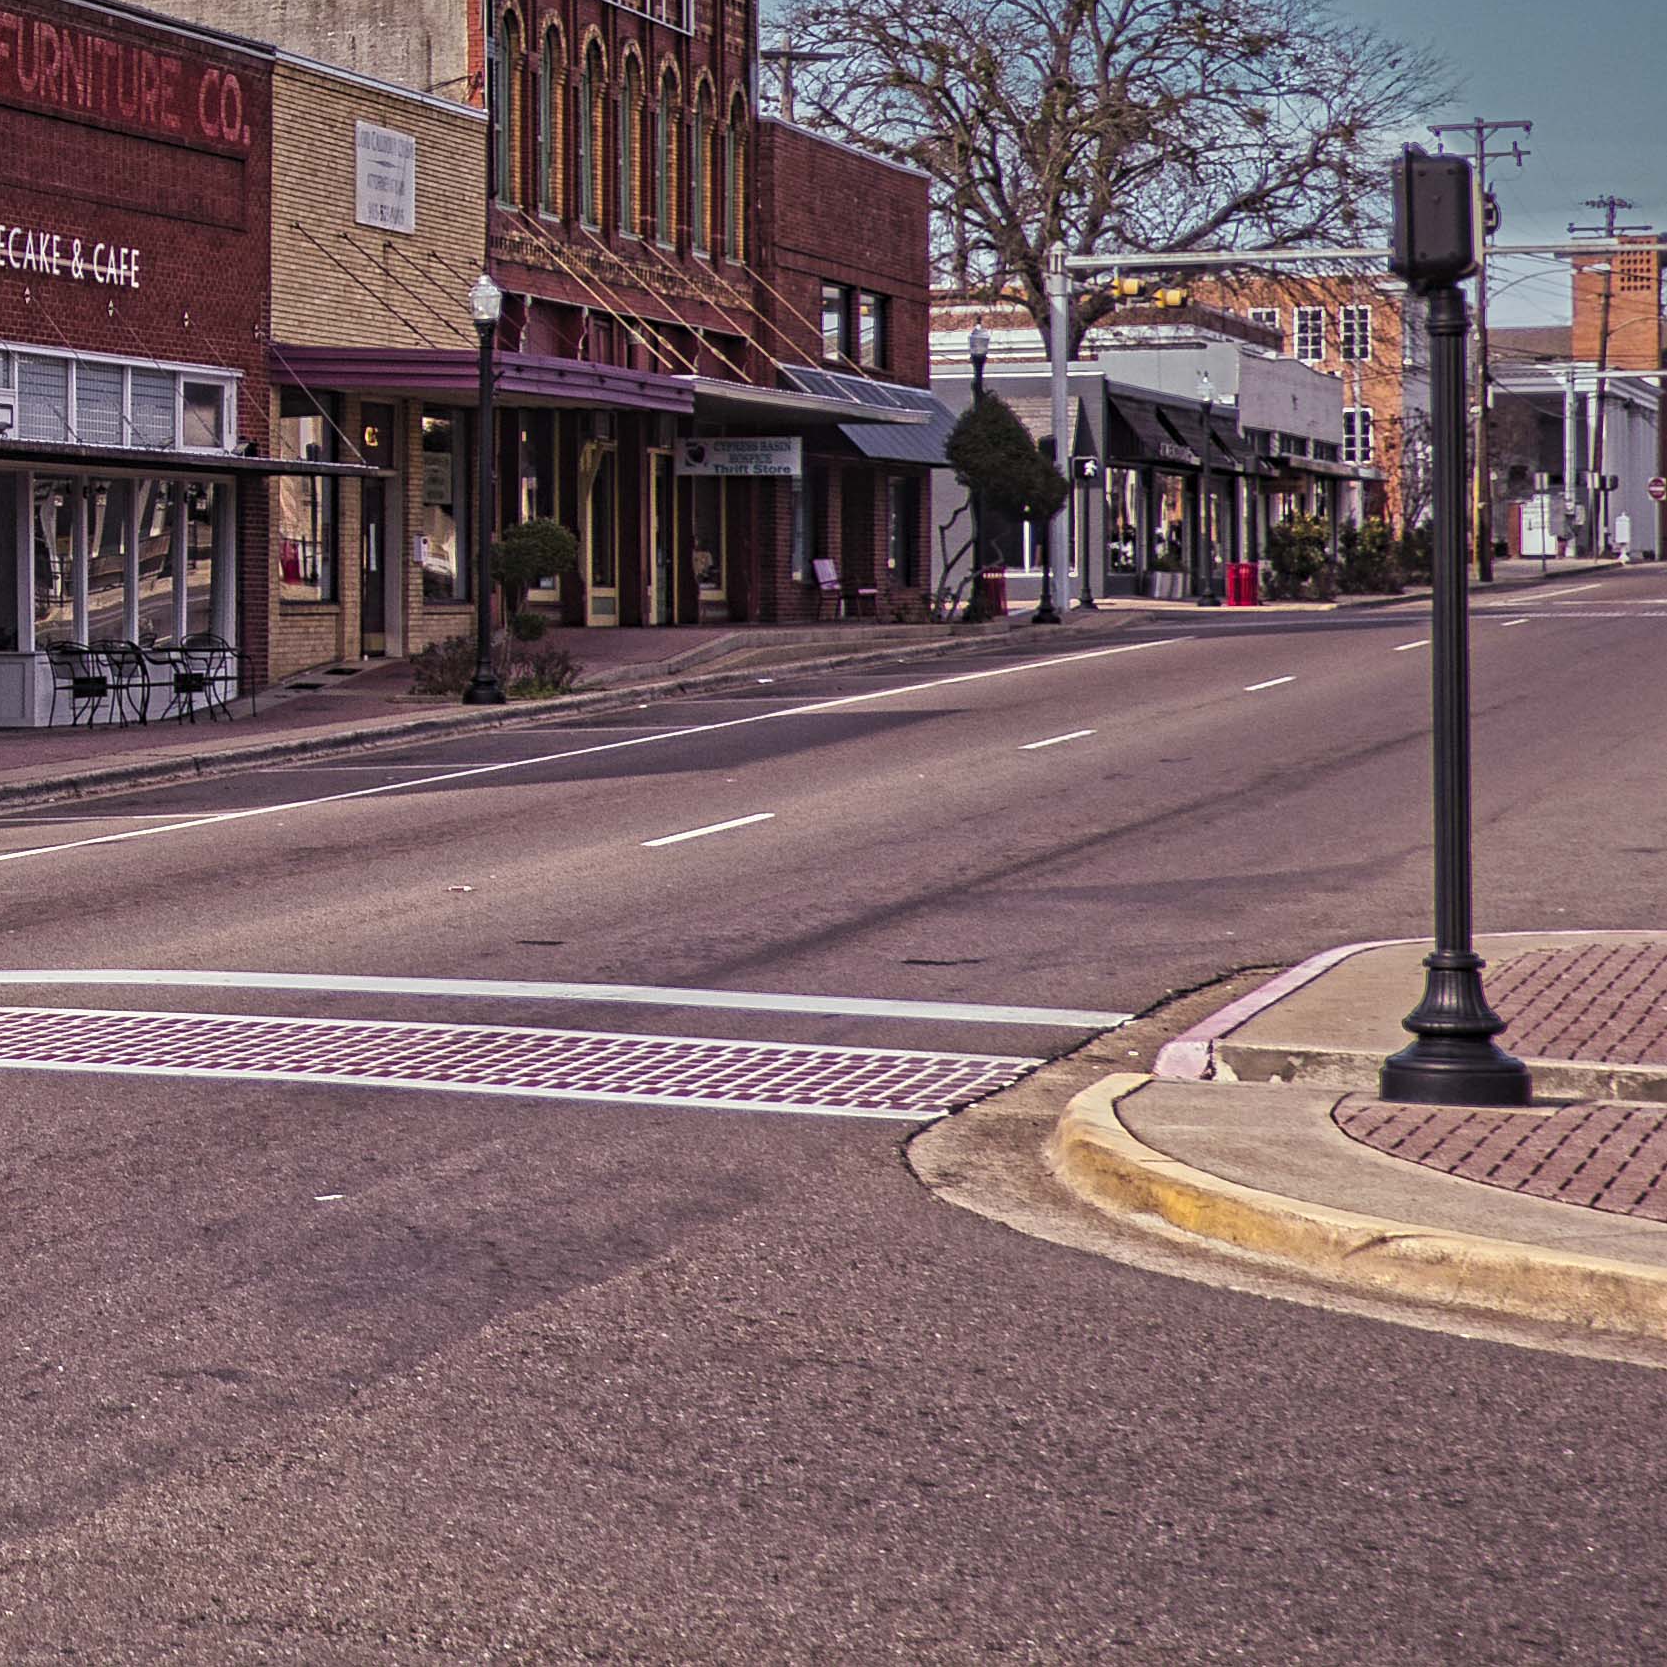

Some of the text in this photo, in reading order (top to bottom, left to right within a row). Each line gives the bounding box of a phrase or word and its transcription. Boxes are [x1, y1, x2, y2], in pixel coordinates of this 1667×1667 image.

[198, 66, 252, 146] CO.
[70, 238, 85, 280] &
[92, 242, 142, 290] CAFE
[712, 463, 792, 474] Thrift Store
